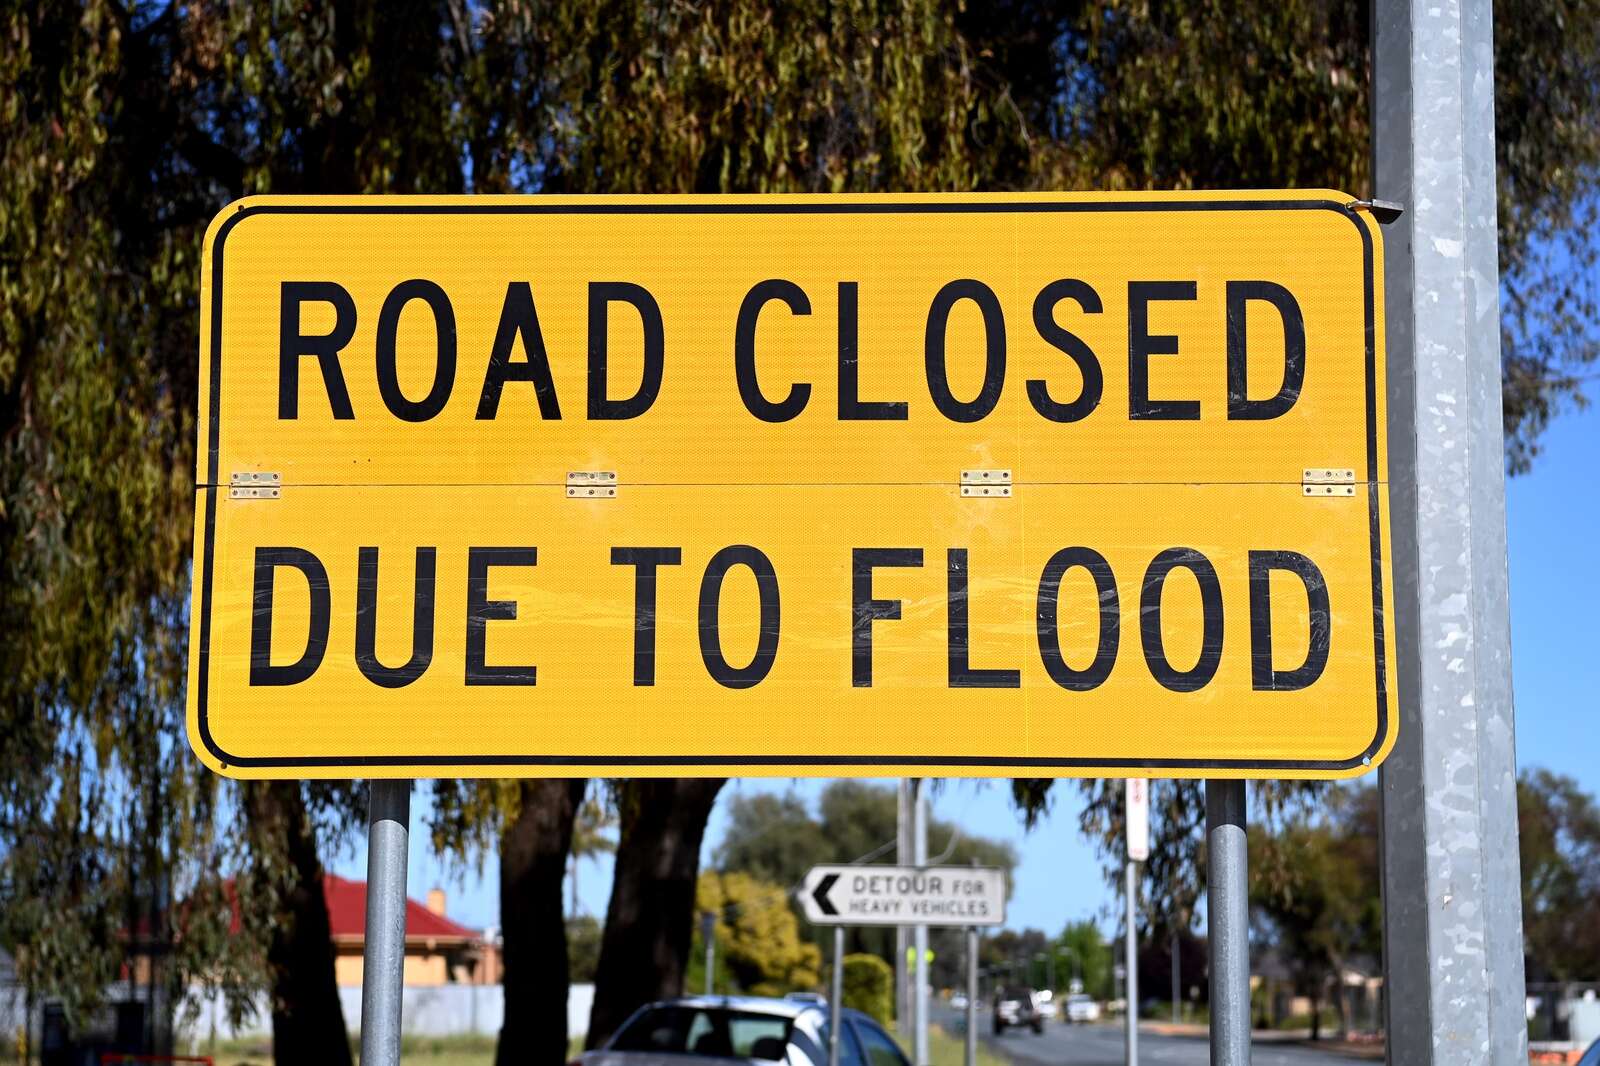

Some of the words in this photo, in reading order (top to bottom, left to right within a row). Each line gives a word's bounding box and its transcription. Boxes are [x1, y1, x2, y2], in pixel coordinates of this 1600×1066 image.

[279, 279, 664, 422] ROAD
[735, 279, 1306, 423] CLOSED
[250, 546, 537, 688] DUE
[611, 545, 780, 689] TO
[852, 547, 1330, 692] FLOOD
[849, 901, 901, 915] HEAVY
[911, 901, 990, 916] VEHICLES
[852, 875, 944, 895] DETOUR
[952, 880, 986, 895] FOR
